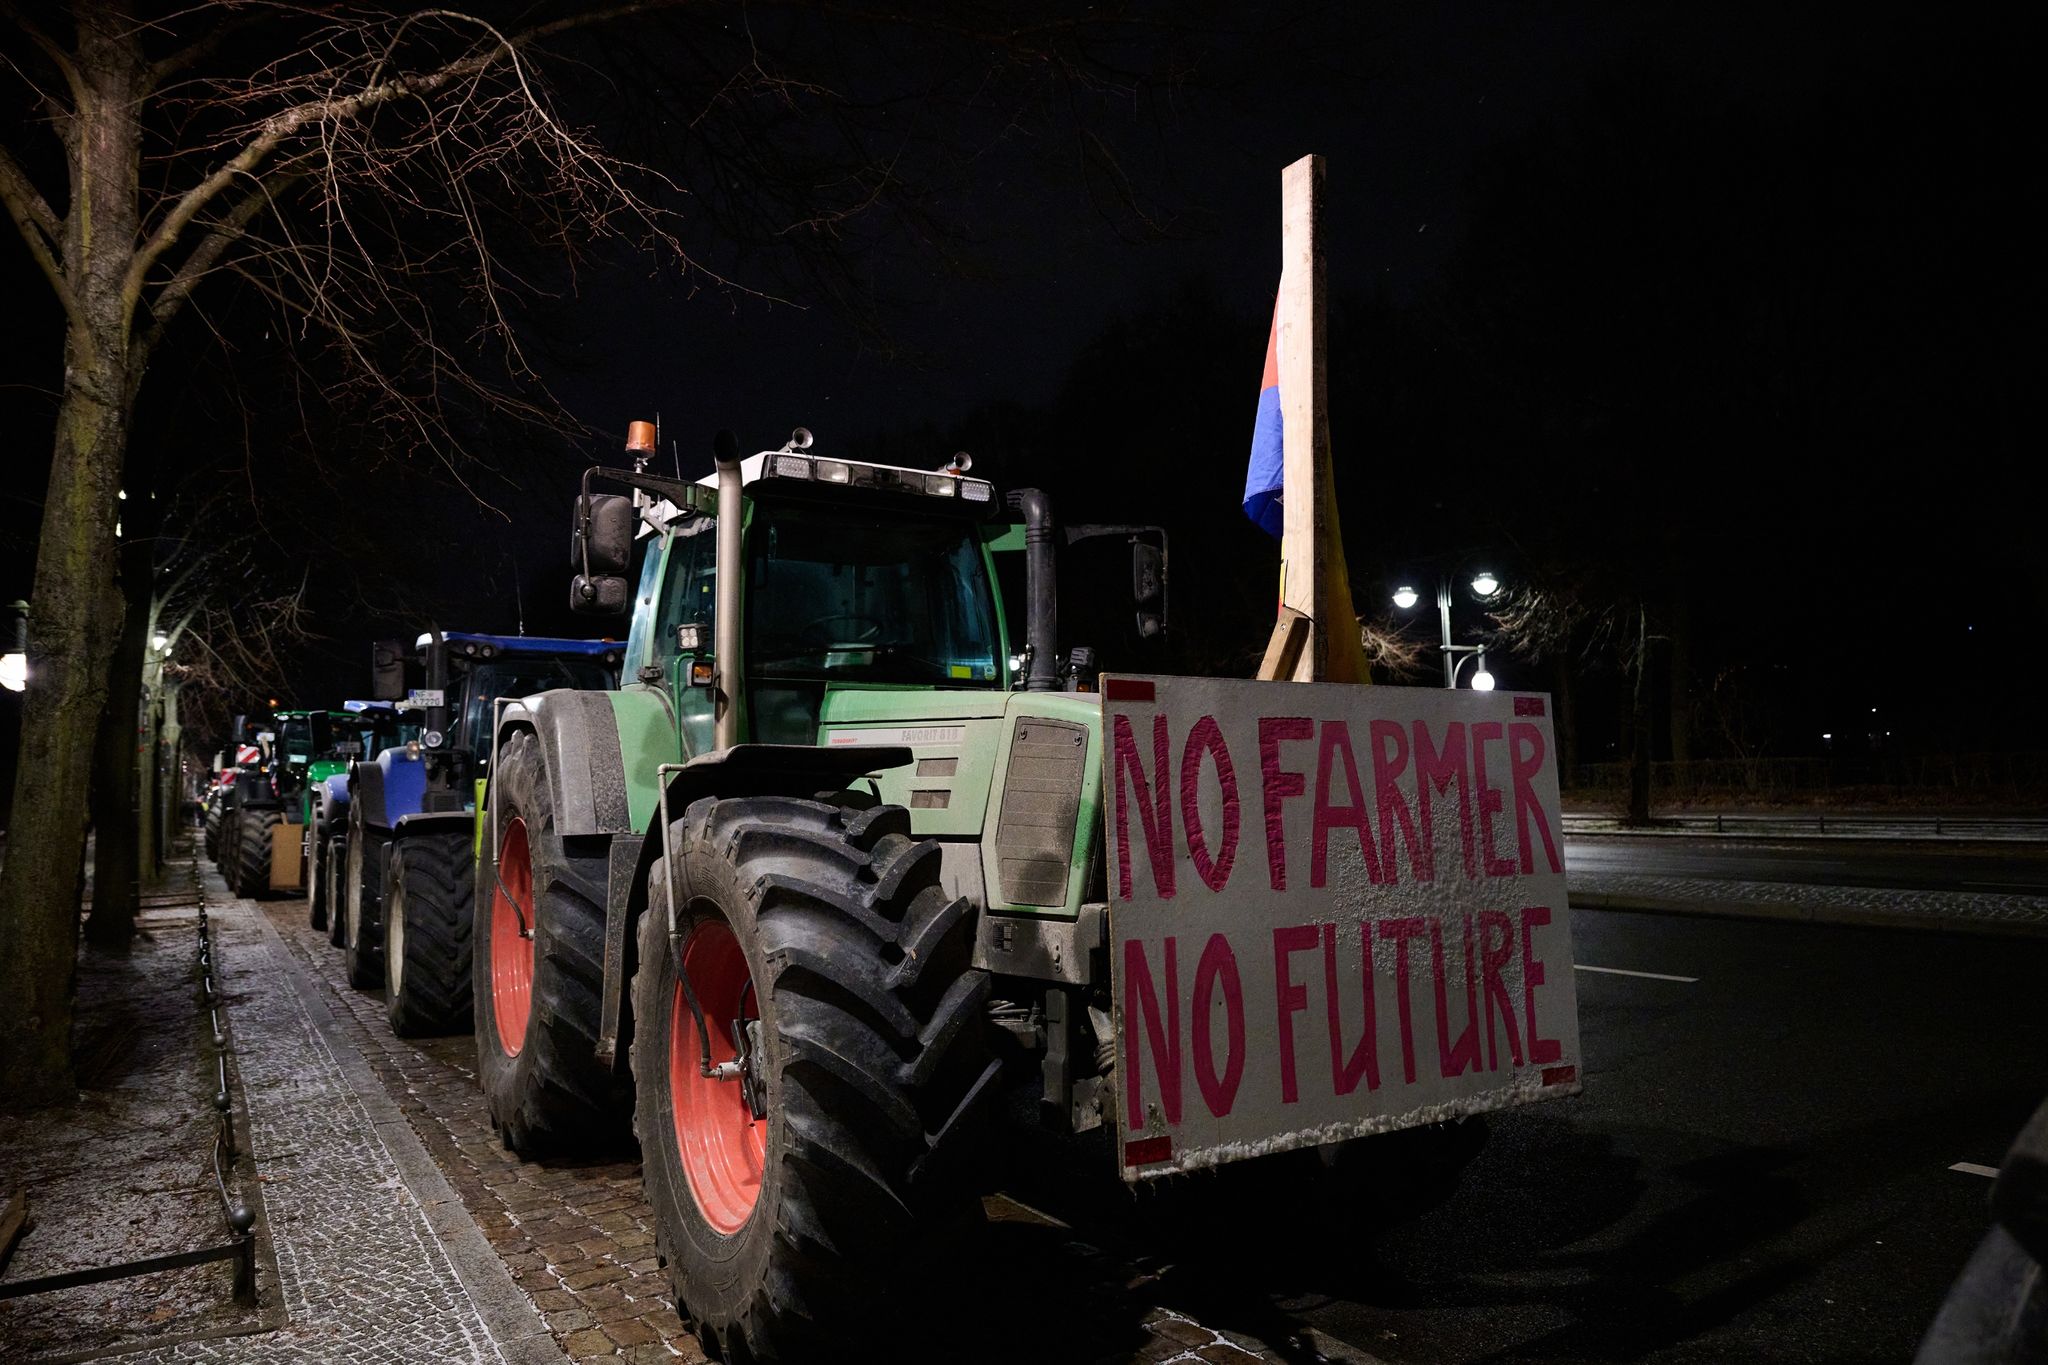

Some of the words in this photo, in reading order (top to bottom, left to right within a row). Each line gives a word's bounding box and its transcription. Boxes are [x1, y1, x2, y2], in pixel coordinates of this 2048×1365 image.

[901, 729, 938, 742] FAVORIT
[1113, 714, 1240, 900] NO
[1258, 716, 1563, 892] FARMER
[1124, 933, 1246, 1130] NO
[1272, 906, 1562, 1104] FUTURE
